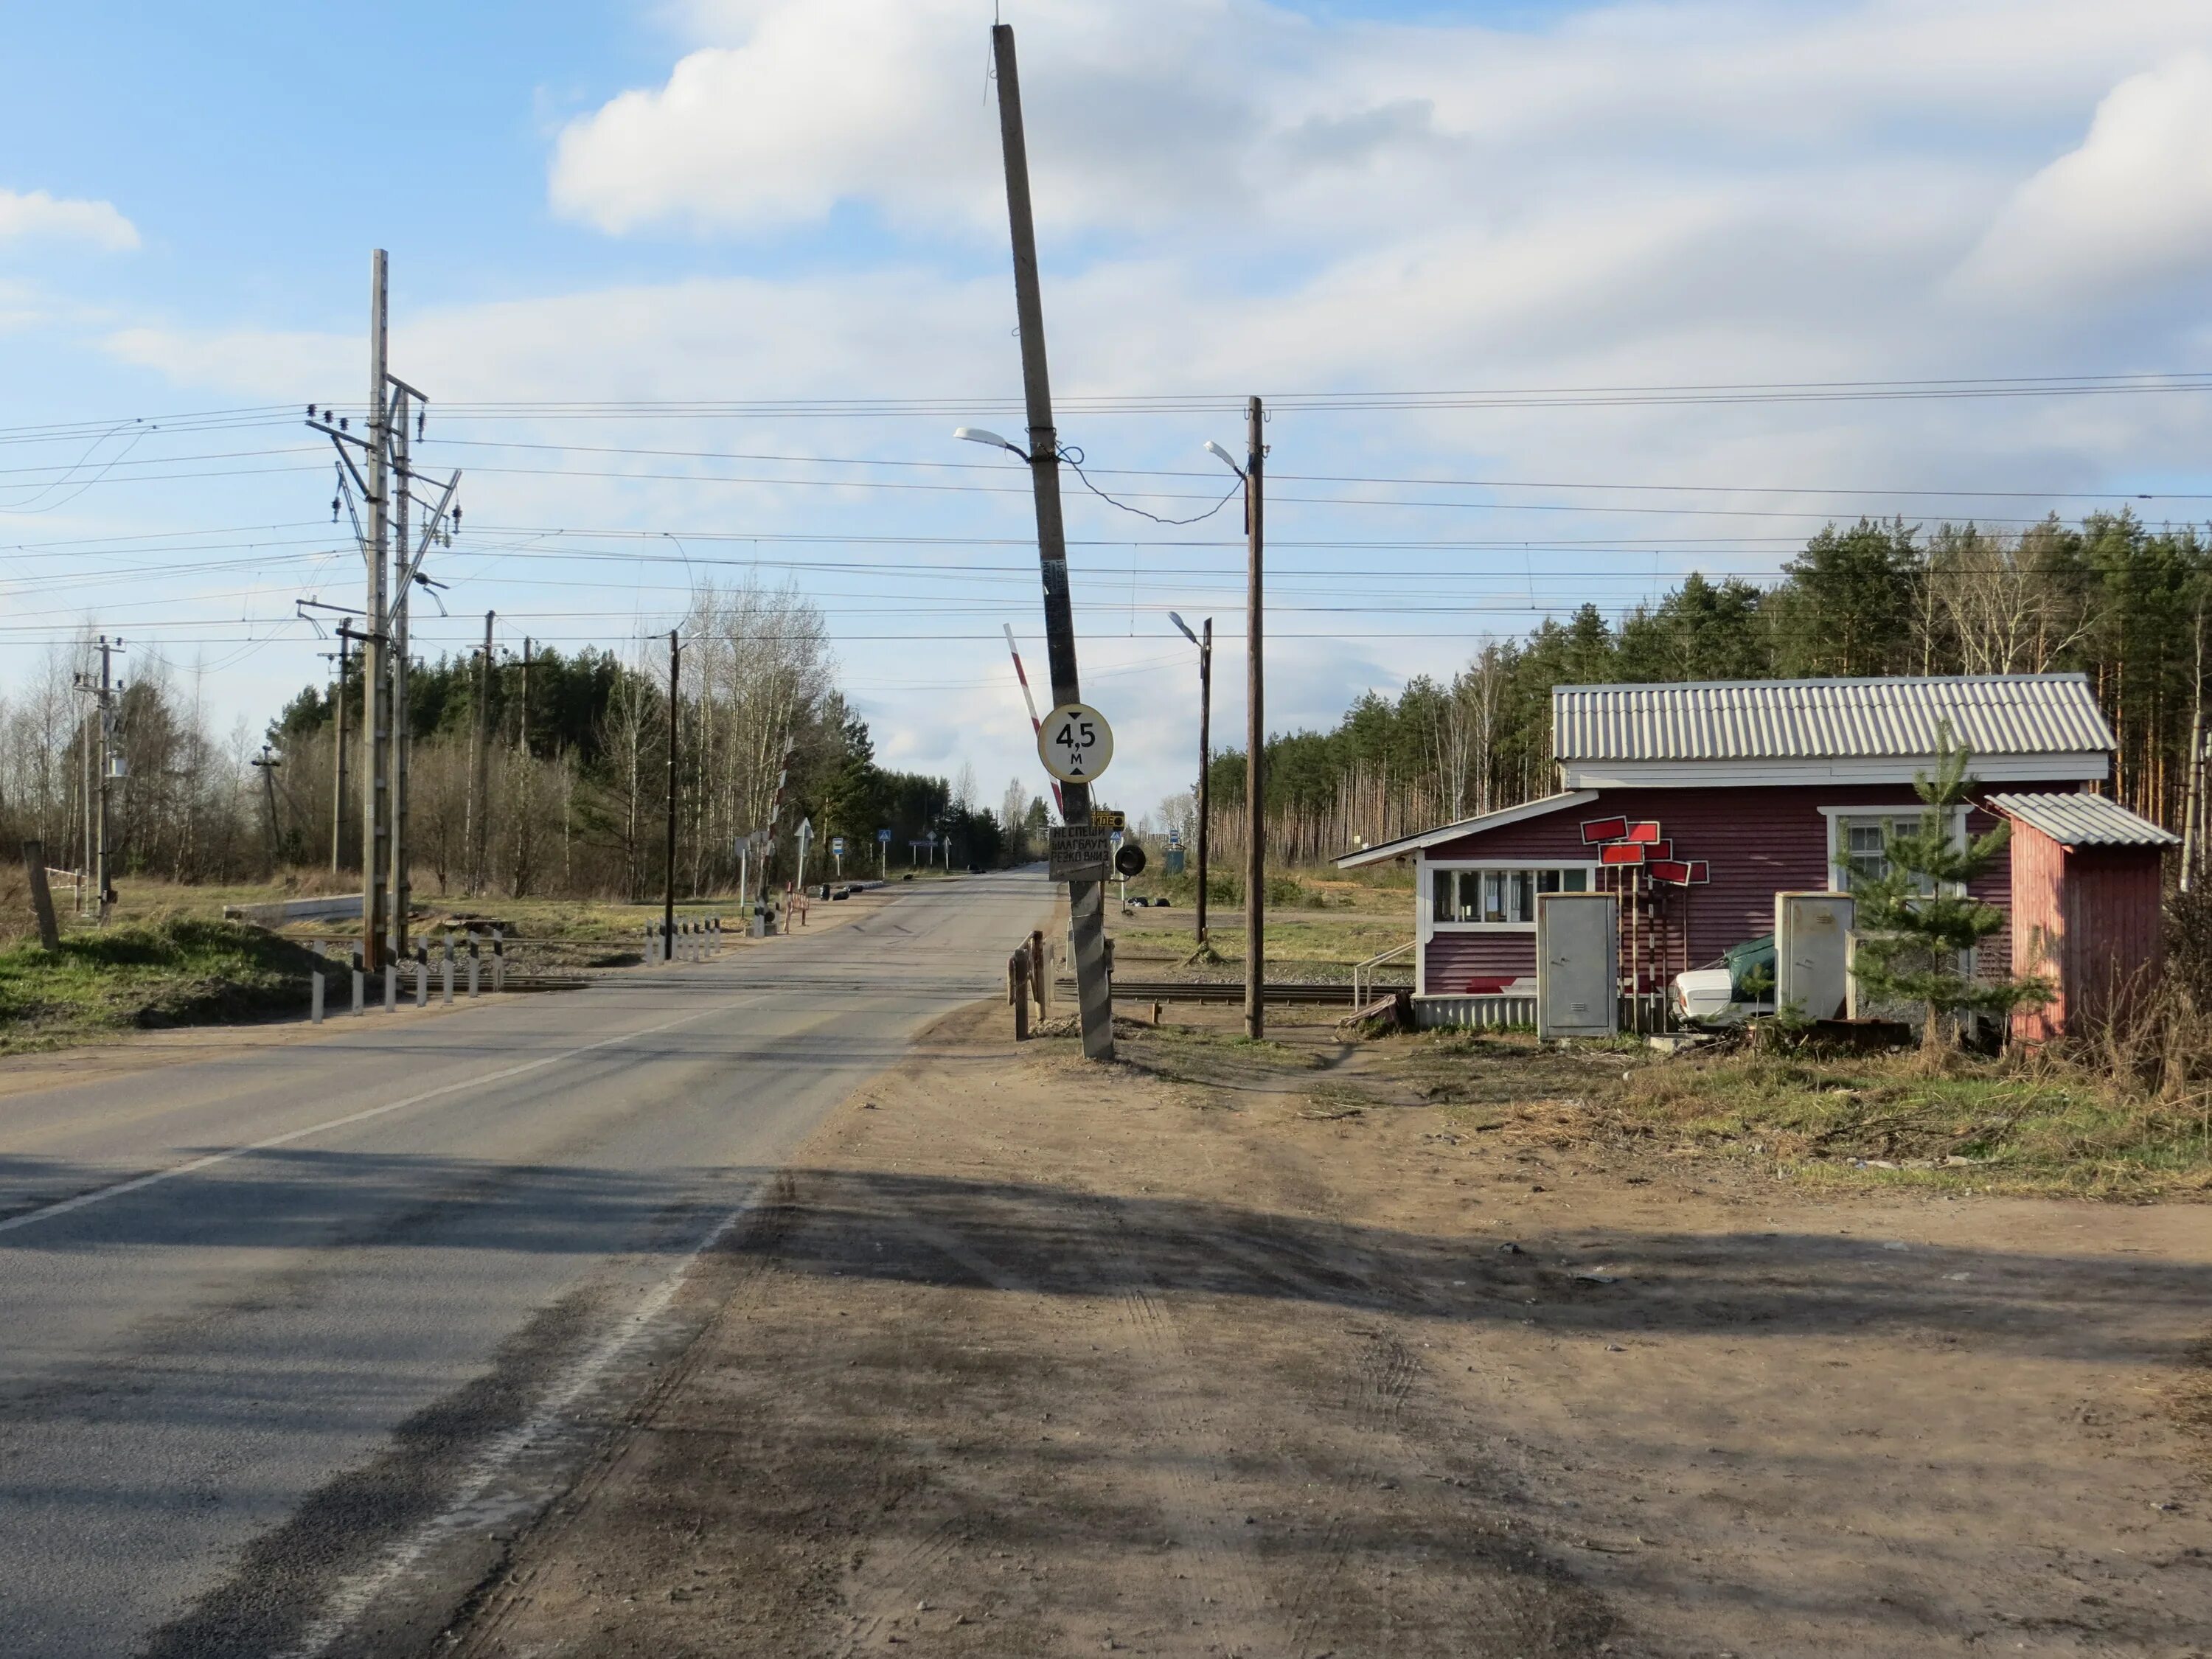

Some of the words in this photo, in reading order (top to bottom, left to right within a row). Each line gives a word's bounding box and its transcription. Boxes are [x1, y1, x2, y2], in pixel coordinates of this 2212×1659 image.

[1056, 723, 1096, 753] 4,5
[1053, 826, 1067, 838] НЕ
[1068, 825, 1105, 837] СПЕШИ
[1051, 838, 1107, 850] ШЛАГБАУМ
[1051, 850, 1082, 863] РЕЗКО
[1084, 850, 1109, 862] ВНИЗ
